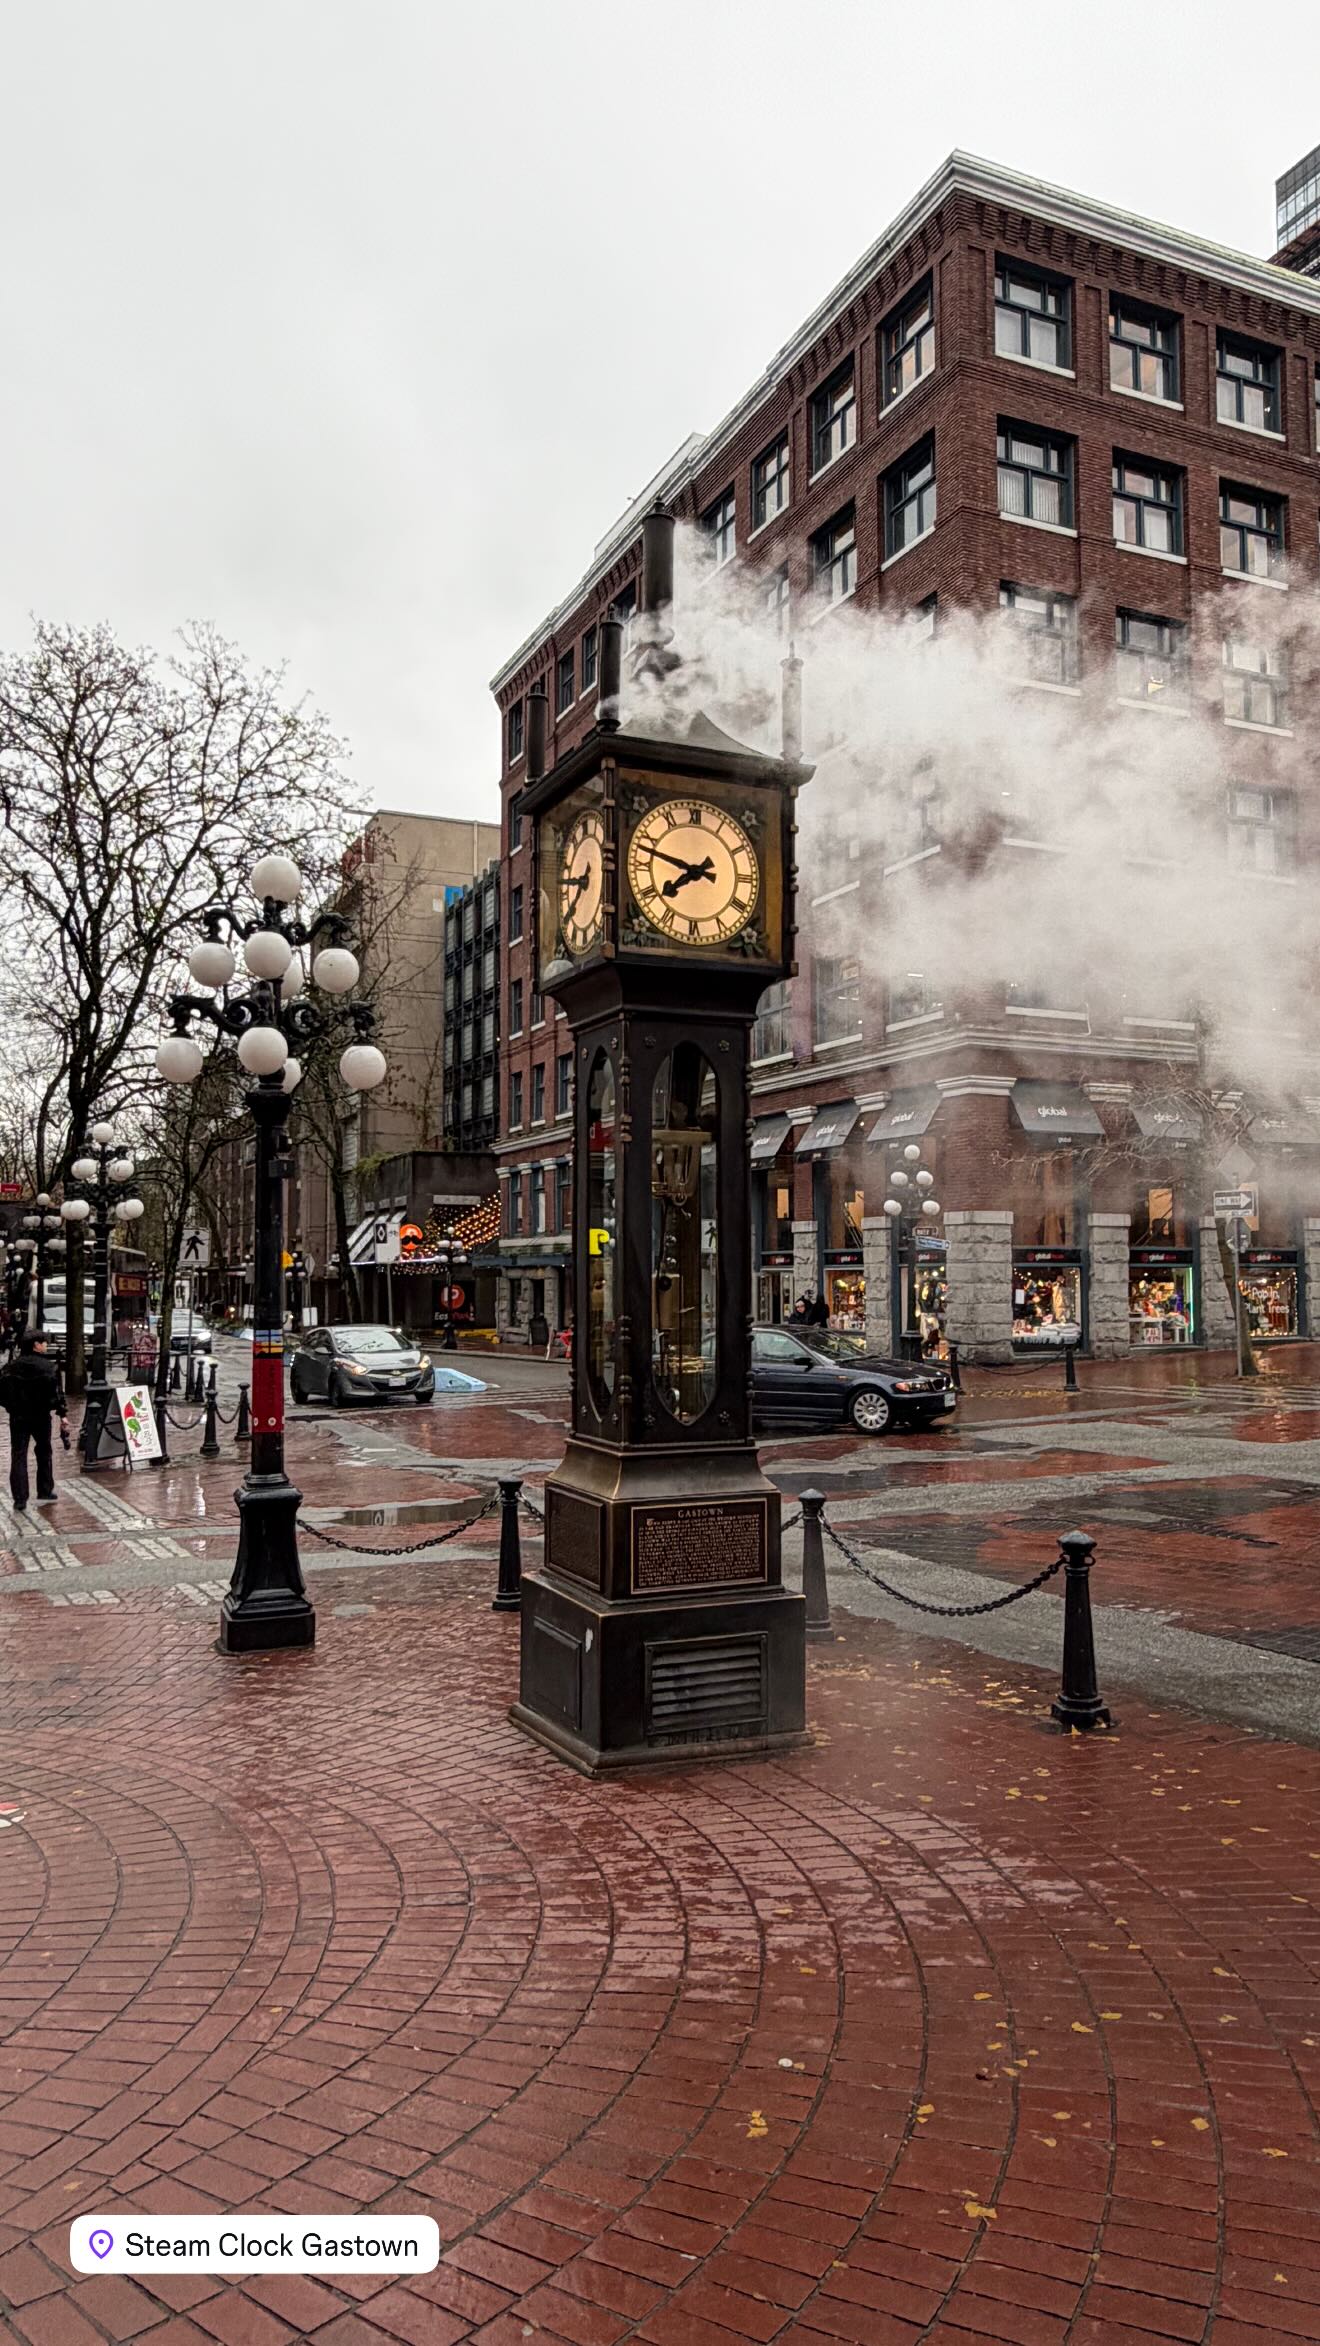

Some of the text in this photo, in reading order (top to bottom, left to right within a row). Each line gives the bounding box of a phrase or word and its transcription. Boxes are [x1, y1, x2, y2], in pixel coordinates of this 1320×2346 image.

[689, 808, 702, 825] XII
[738, 873, 752, 884] III
[716, 917, 728, 935] V
[1037, 1106, 1068, 1117] global
[678, 1508, 724, 1518] GASTOWN
